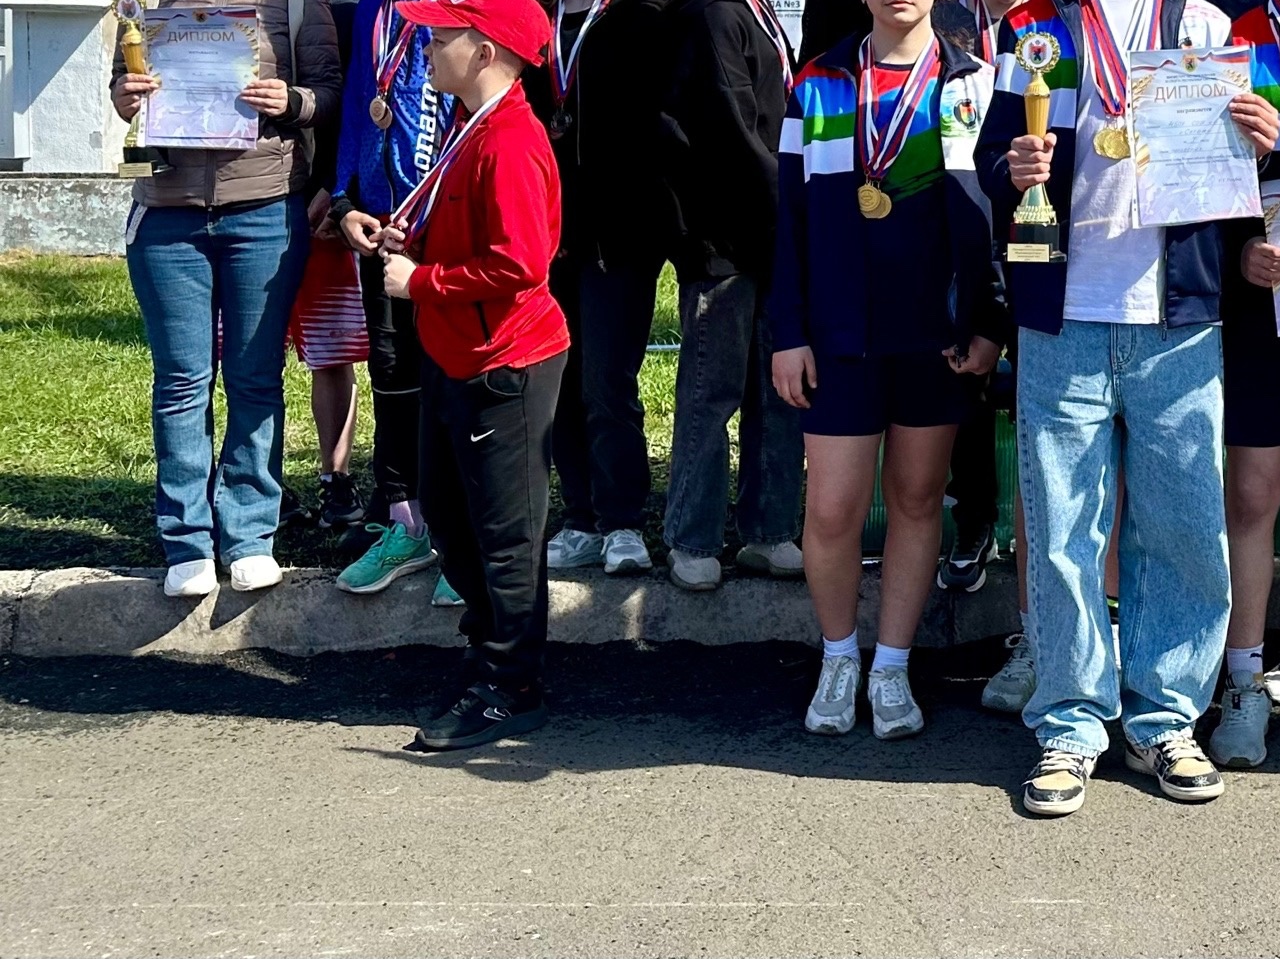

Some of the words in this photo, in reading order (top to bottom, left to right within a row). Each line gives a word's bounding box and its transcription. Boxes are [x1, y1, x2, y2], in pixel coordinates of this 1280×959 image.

[784, 0, 800, 8] №3
[167, 30, 235, 44] ДИПЛОМ
[1154, 81, 1228, 103] ДИПЛОМ
